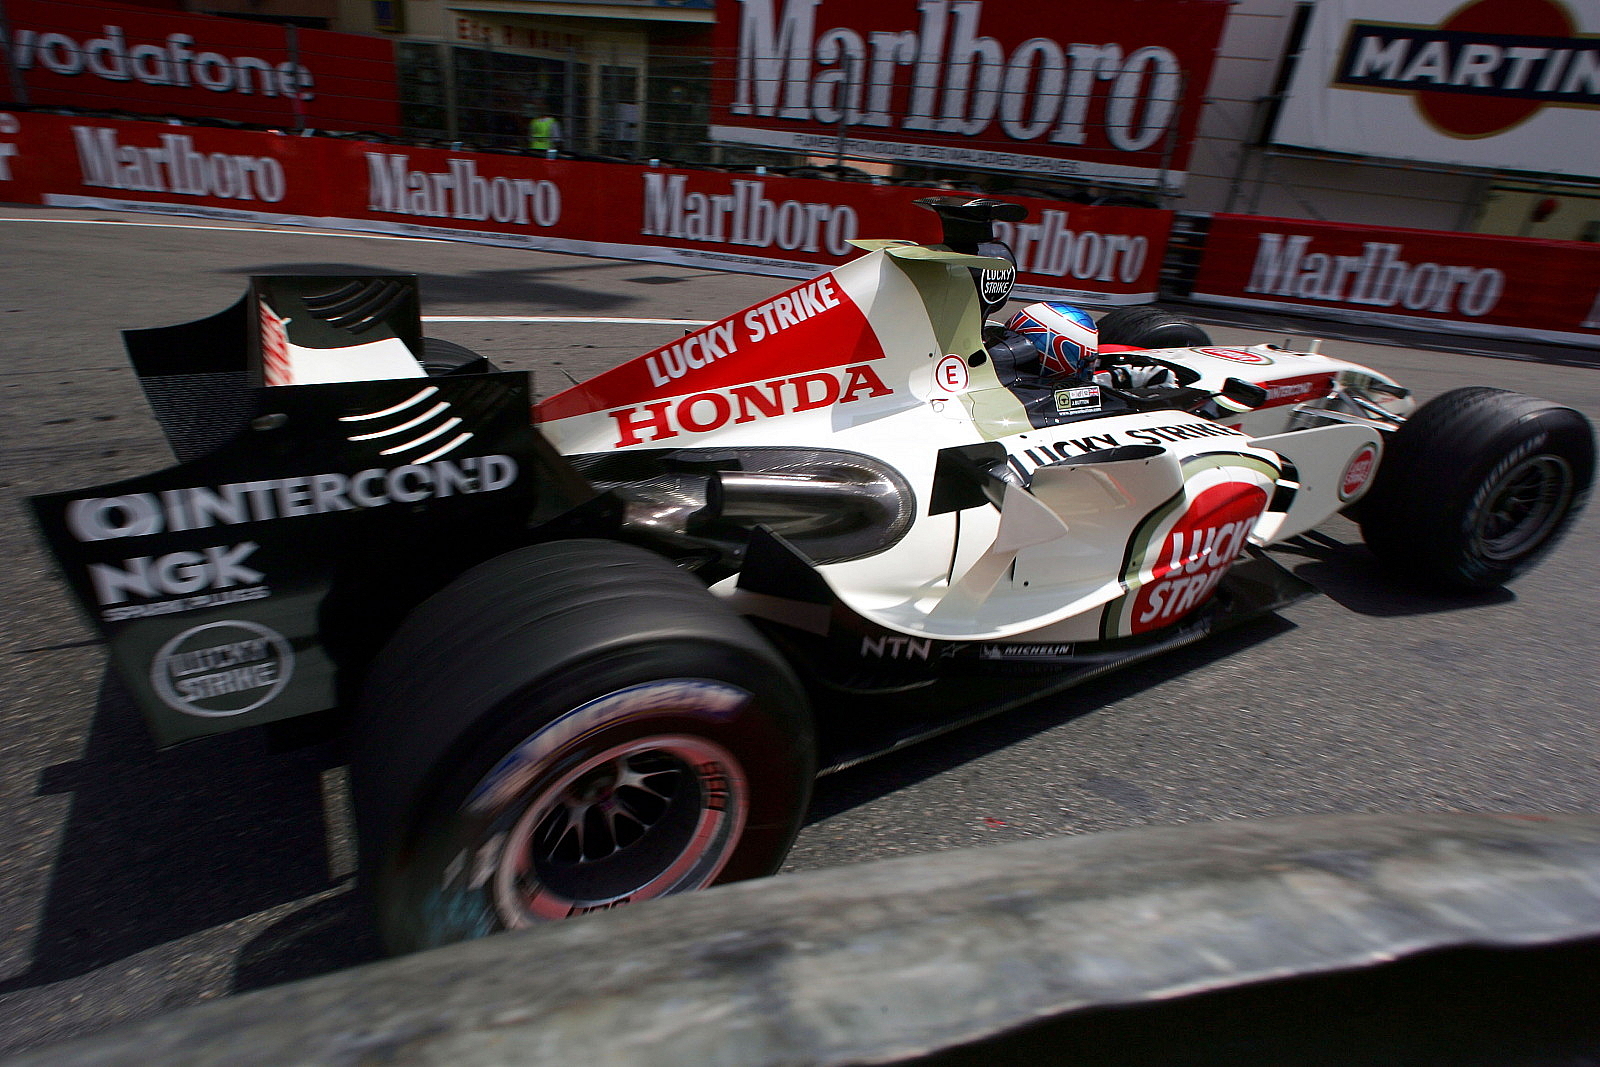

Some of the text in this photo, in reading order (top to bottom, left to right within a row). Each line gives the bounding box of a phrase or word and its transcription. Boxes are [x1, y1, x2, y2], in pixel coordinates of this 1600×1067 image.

[730, 0, 1182, 152] Marlboro
[71, 125, 287, 203] Marlboro
[365, 151, 561, 227] Marlboro
[641, 171, 859, 257] Marlboro
[992, 208, 1148, 284] arlboro
[984, 281, 1009, 295] STRIKE
[986, 268, 1012, 281] LUCKY
[1245, 232, 1505, 317] Marlboro
[645, 277, 841, 388] LUCKY STRIKE
[609, 364, 894, 449] HONDA
[946, 364, 959, 384] E
[1125, 422, 1245, 446] STRIKE
[164, 454, 519, 530] INTERCOND
[89, 541, 267, 604] NGK
[860, 635, 933, 662] NTN
[1003, 643, 1070, 656] MICHELIN
